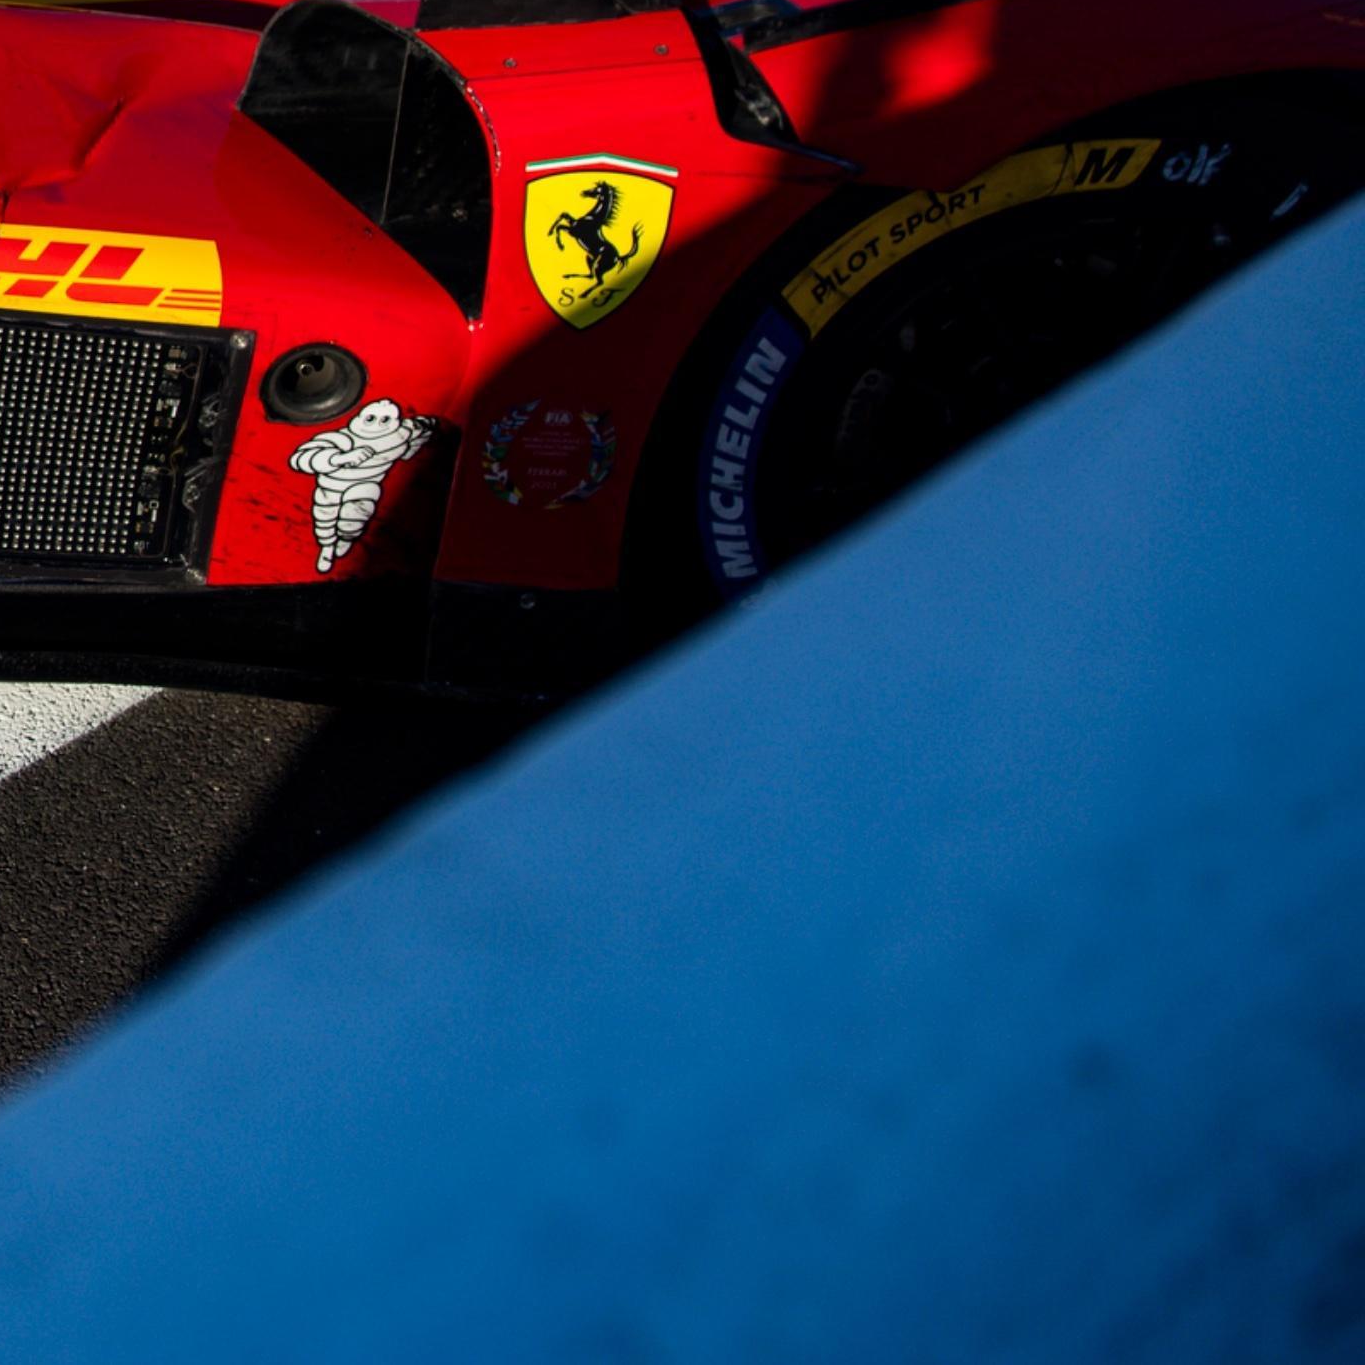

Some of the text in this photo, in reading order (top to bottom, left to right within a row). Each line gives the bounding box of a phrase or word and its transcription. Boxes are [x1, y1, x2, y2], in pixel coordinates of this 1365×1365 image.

[1073, 147, 1137, 186] M
[810, 183, 987, 305] PILOT SPORT
[709, 337, 788, 579] MICHELIN
